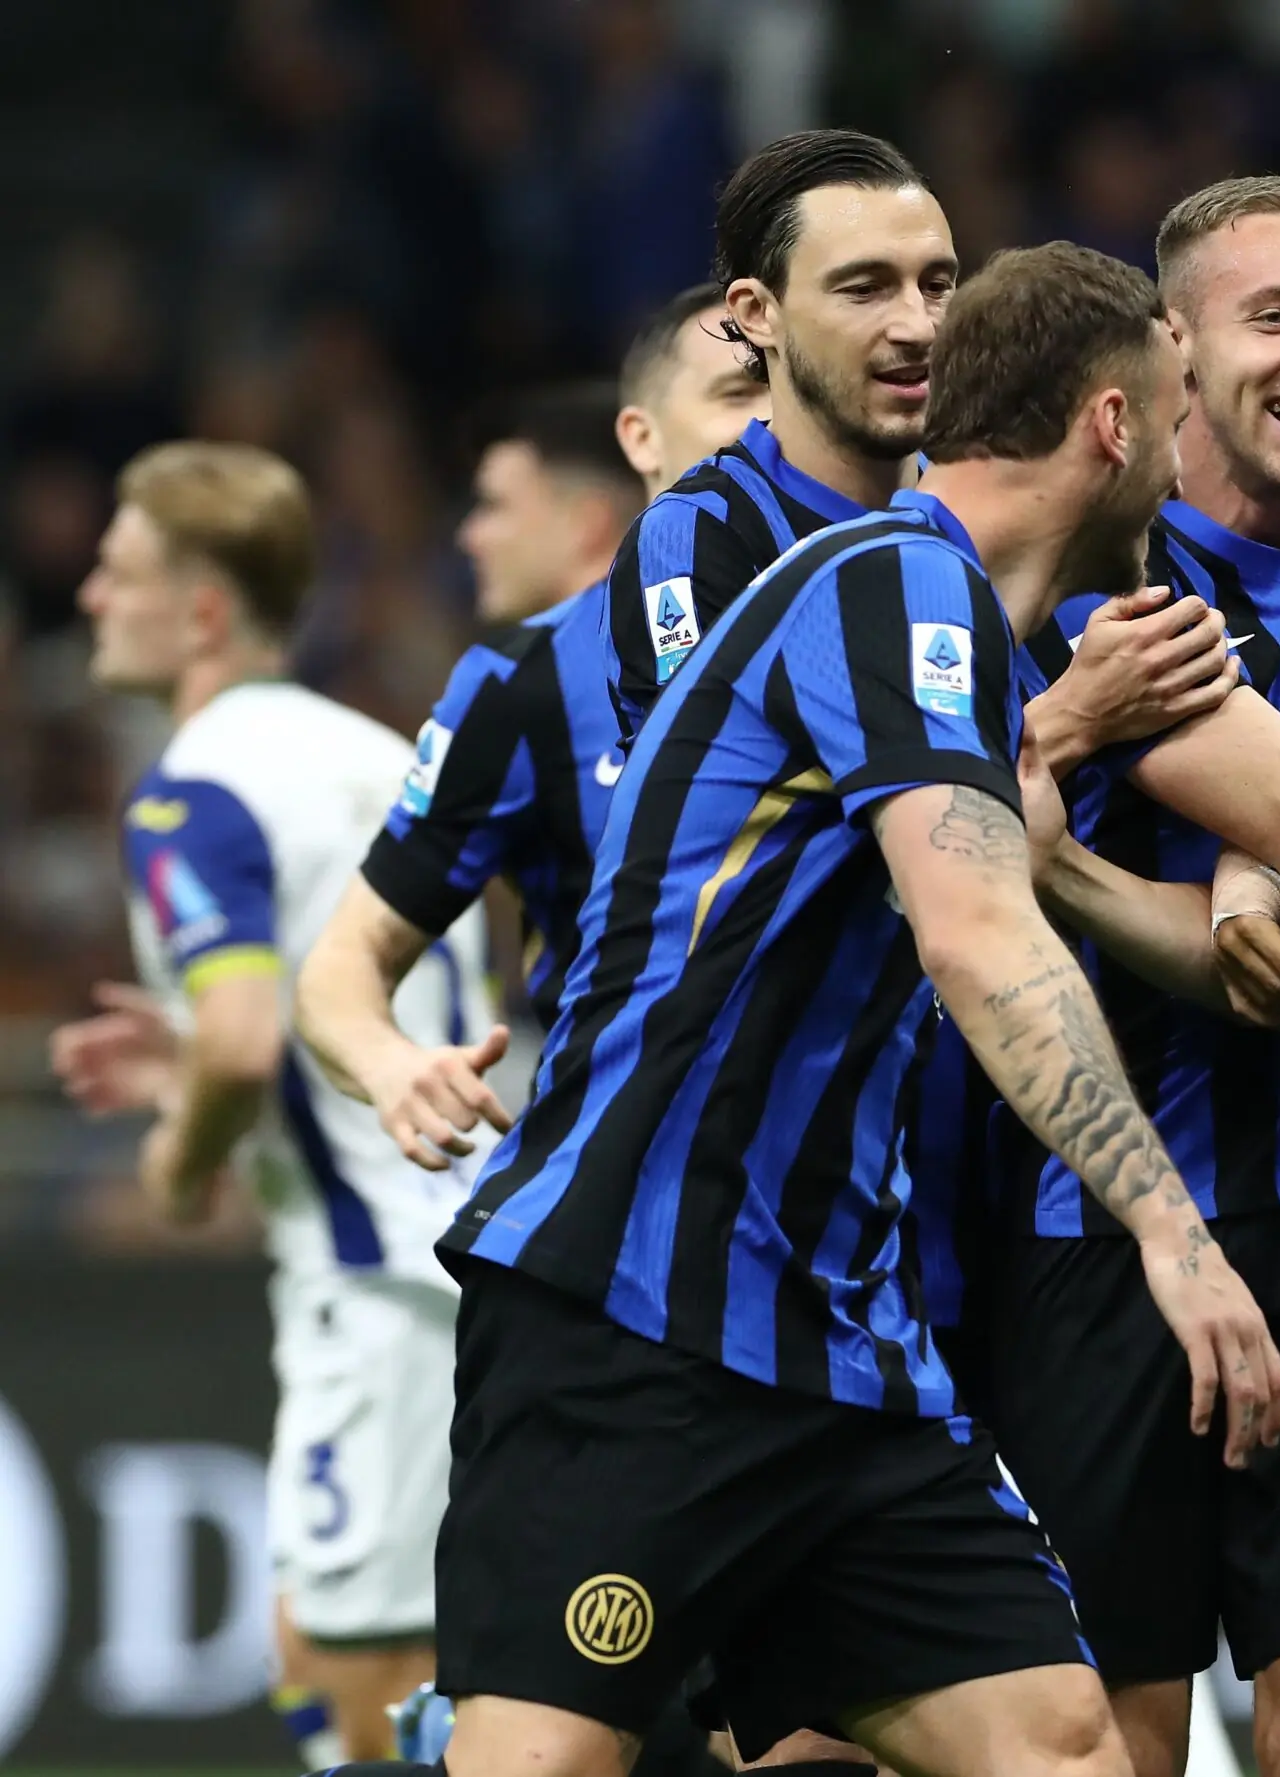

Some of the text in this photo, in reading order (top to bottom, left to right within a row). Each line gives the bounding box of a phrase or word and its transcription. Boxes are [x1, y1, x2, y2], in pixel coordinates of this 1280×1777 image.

[659, 629, 692, 646] SERIE A
[923, 671, 952, 682] SERIE
